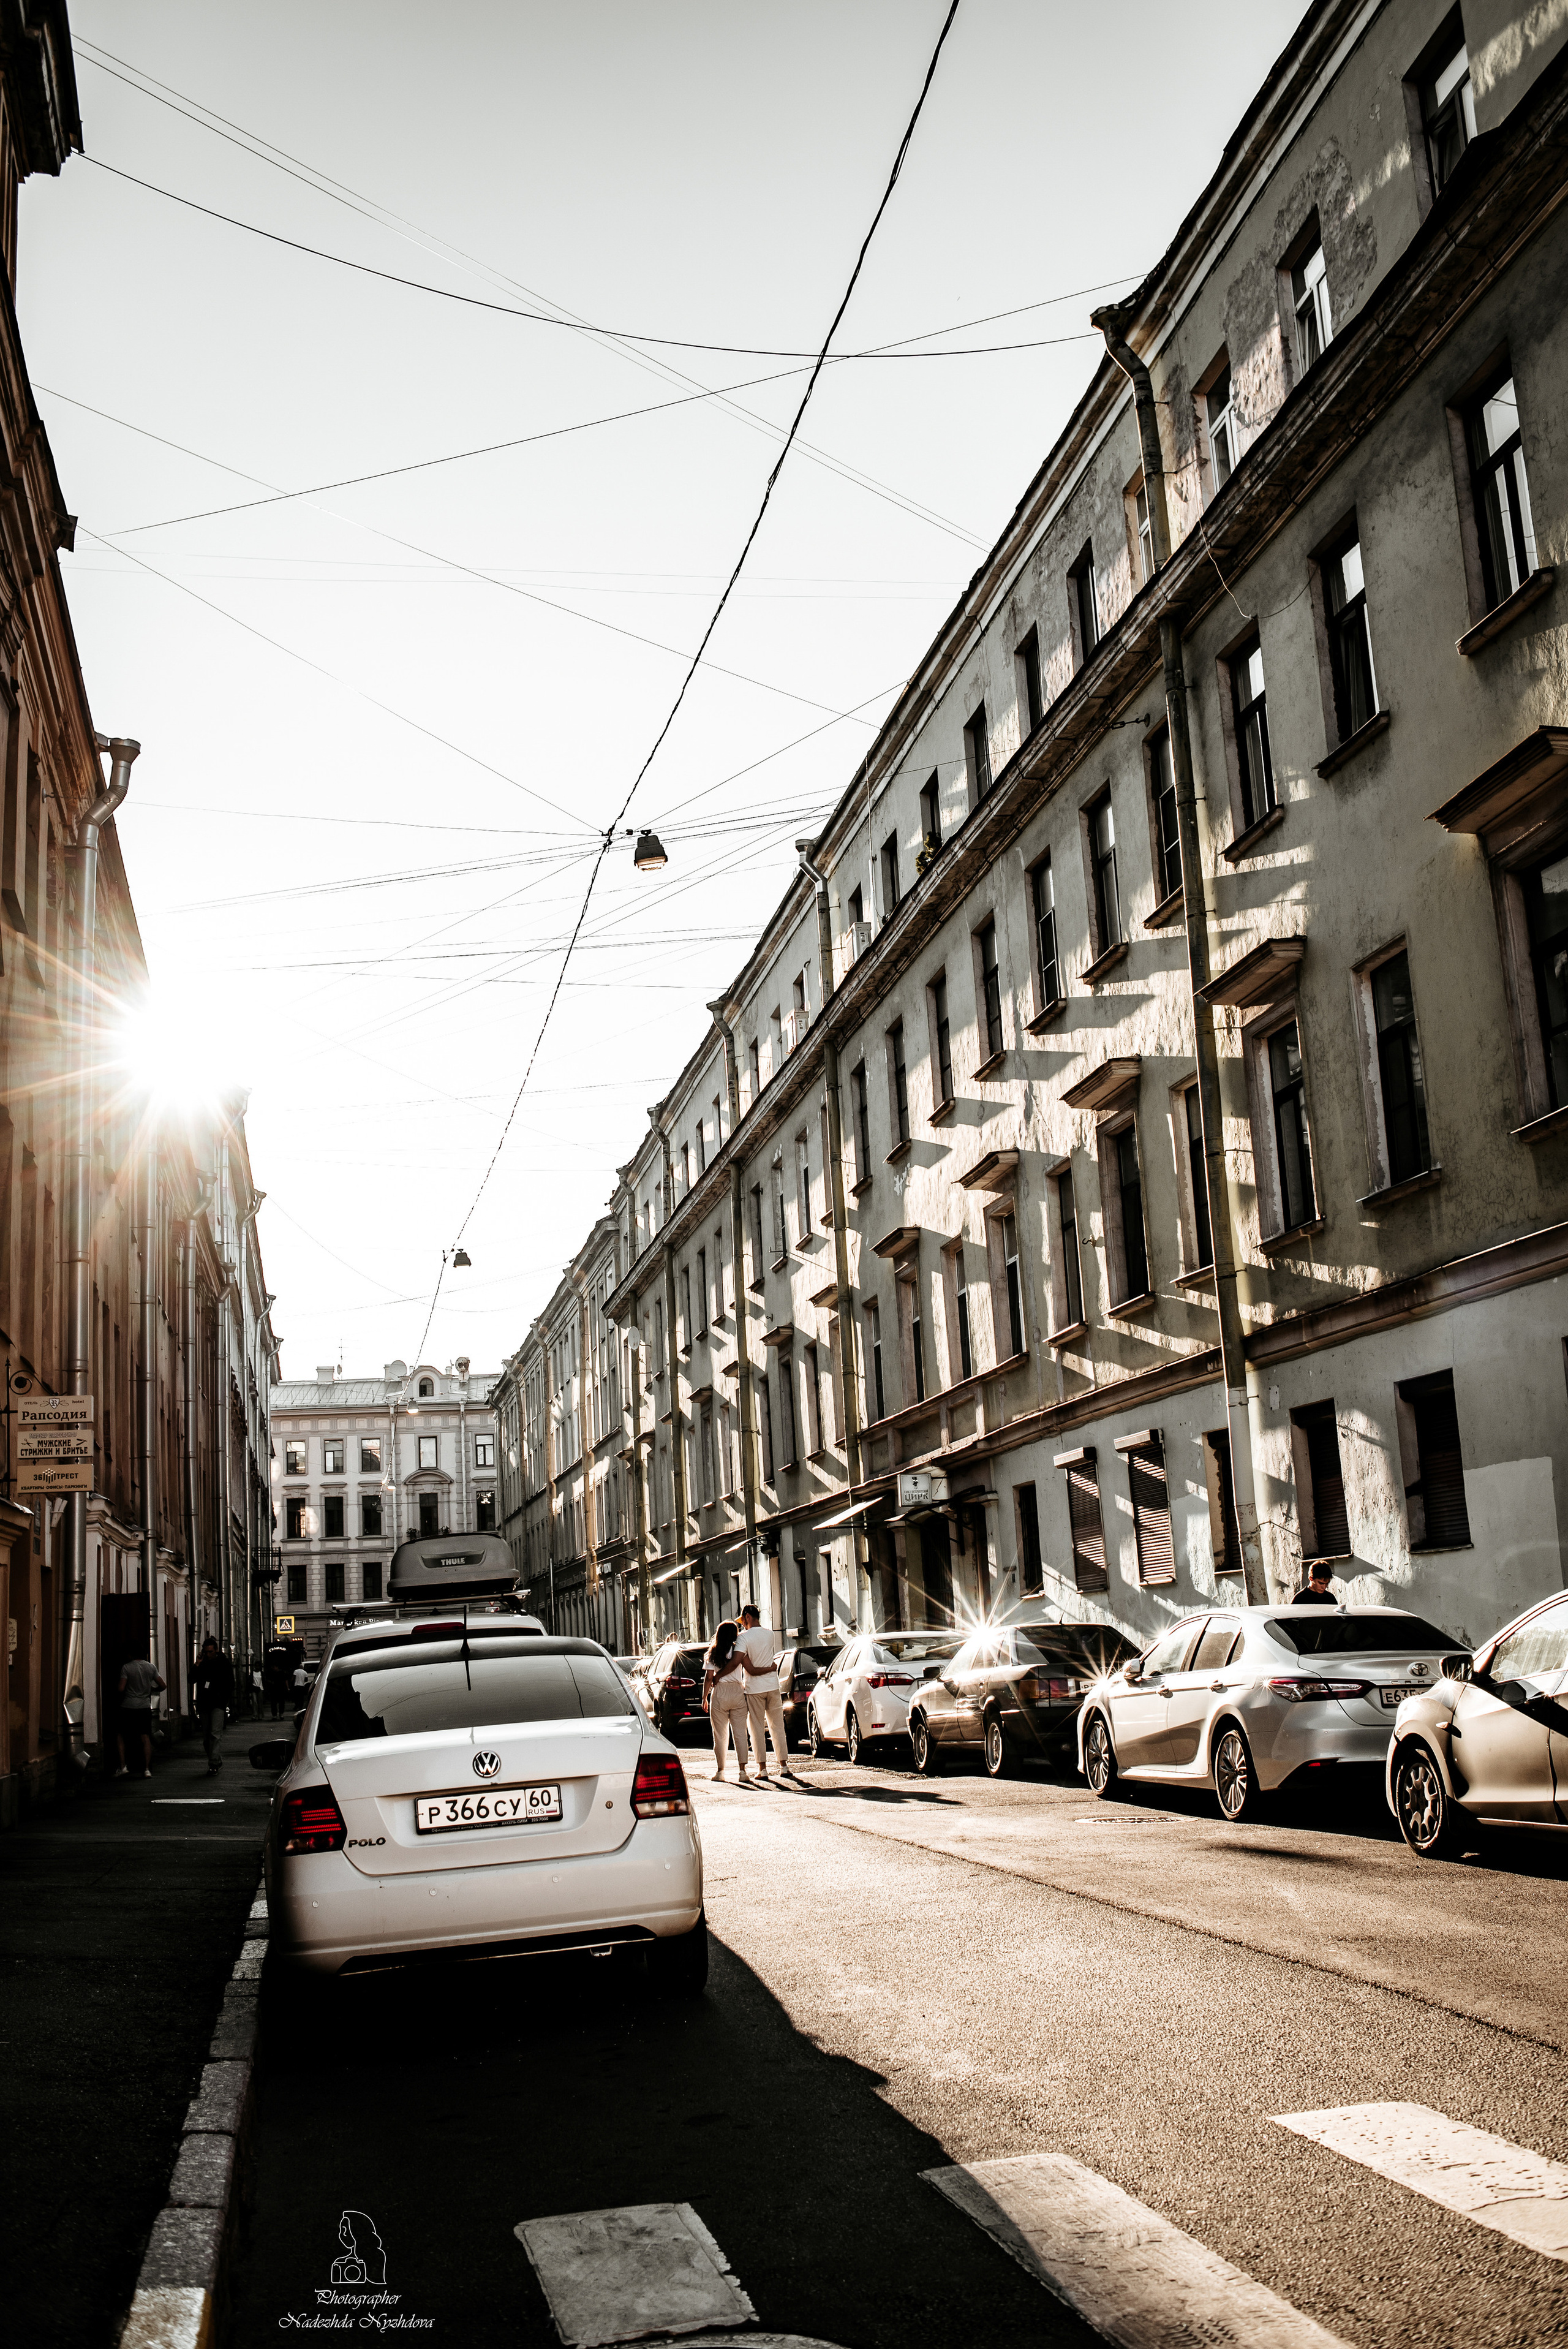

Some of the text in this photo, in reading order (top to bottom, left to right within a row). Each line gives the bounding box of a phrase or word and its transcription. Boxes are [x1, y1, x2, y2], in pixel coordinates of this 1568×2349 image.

[21, 1411, 87, 1421] Рапсодия
[529, 1790, 551, 1807] 60
[349, 1837, 386, 1848] POLO
